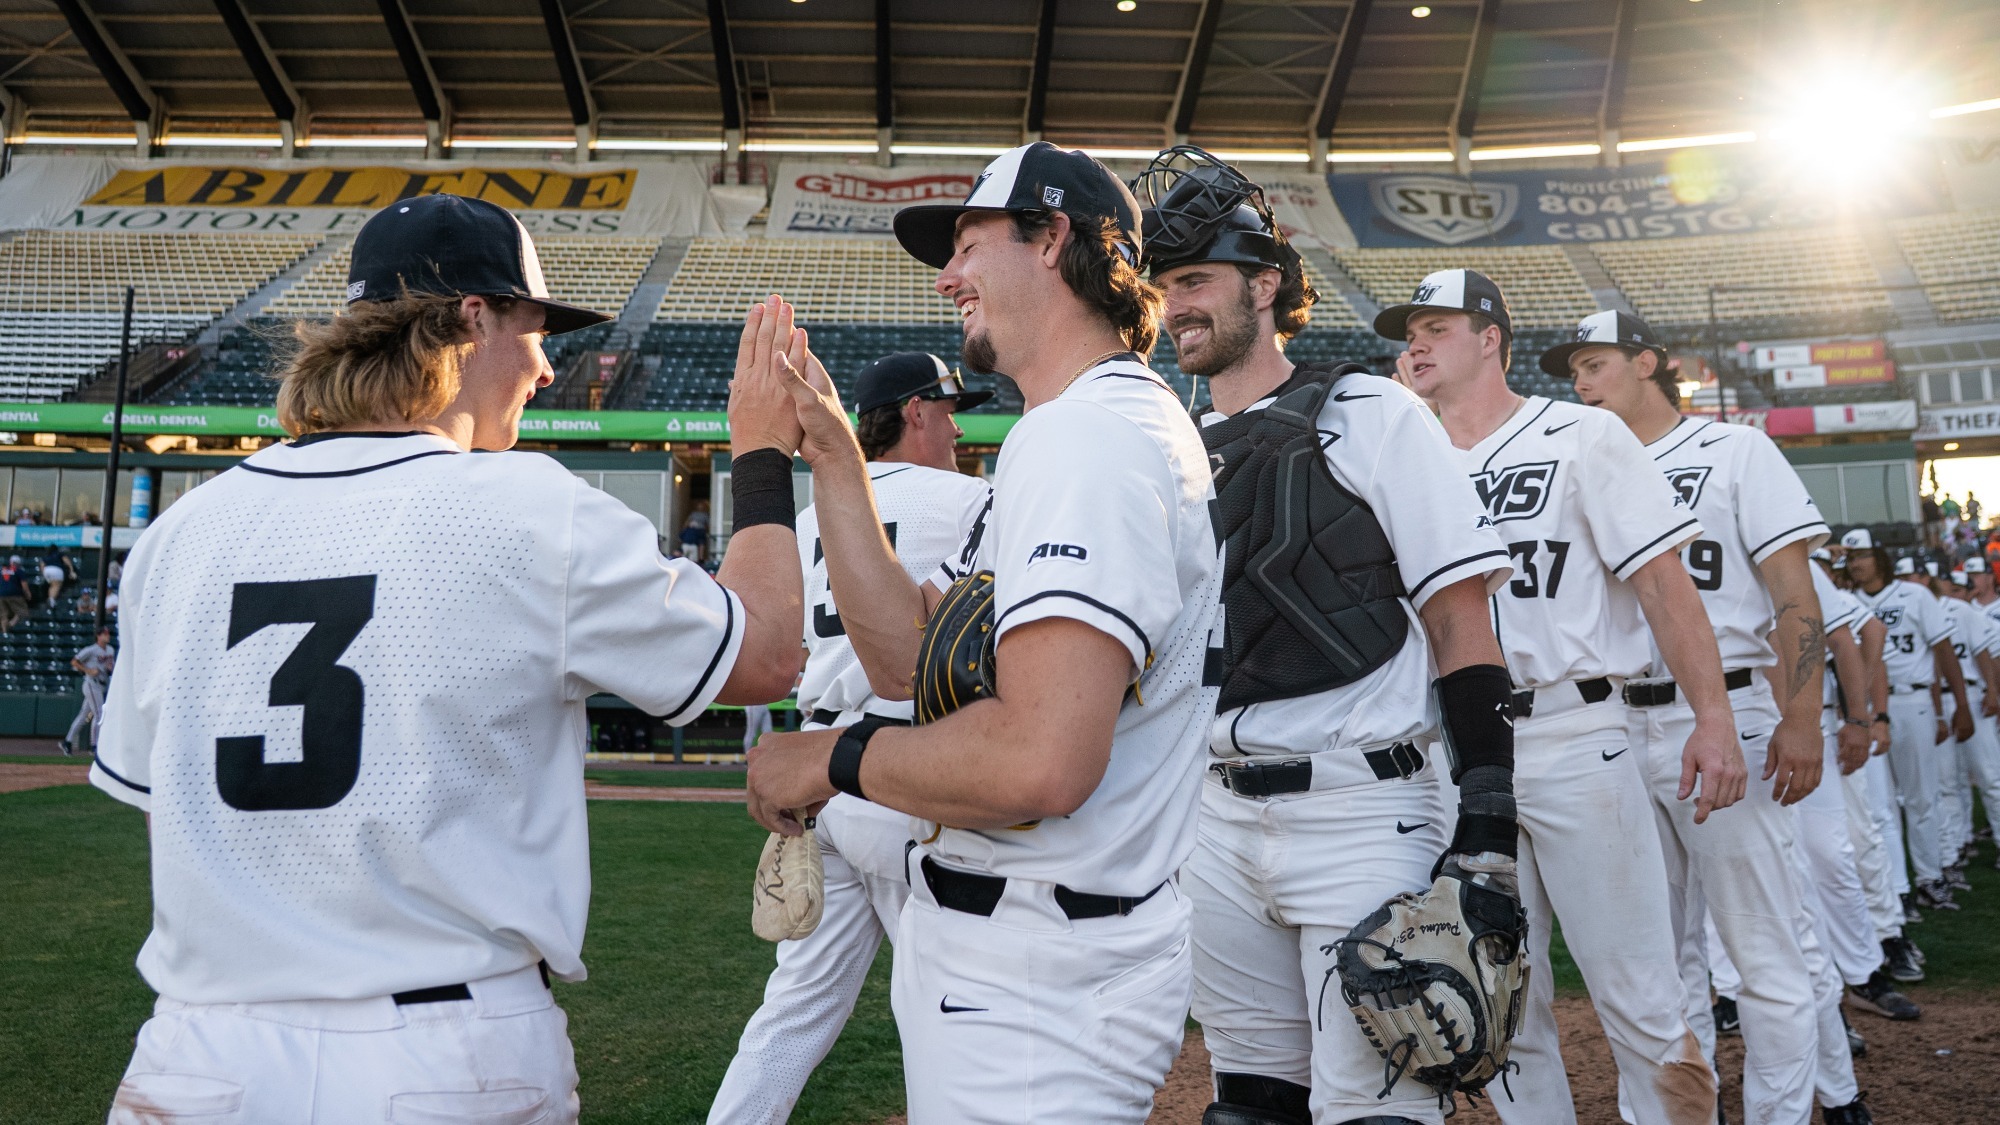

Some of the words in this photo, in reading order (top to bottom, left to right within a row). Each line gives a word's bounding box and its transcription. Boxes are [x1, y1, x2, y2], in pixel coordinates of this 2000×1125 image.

[94, 168, 627, 208] ABILENE
[798, 174, 972, 202] Gilbane
[1397, 189, 1494, 219] STG
[57, 209, 299, 231] MOTOR
[123, 414, 156, 425] DELTA
[160, 415, 207, 426] DENTAL
[552, 421, 600, 431] DENTAL
[686, 422, 722, 431] DELTA
[1943, 411, 2000, 431] THEF
[1508, 540, 1571, 599] 37
[216, 574, 377, 811] 3
[1419, 921, 1461, 936] Psalms
